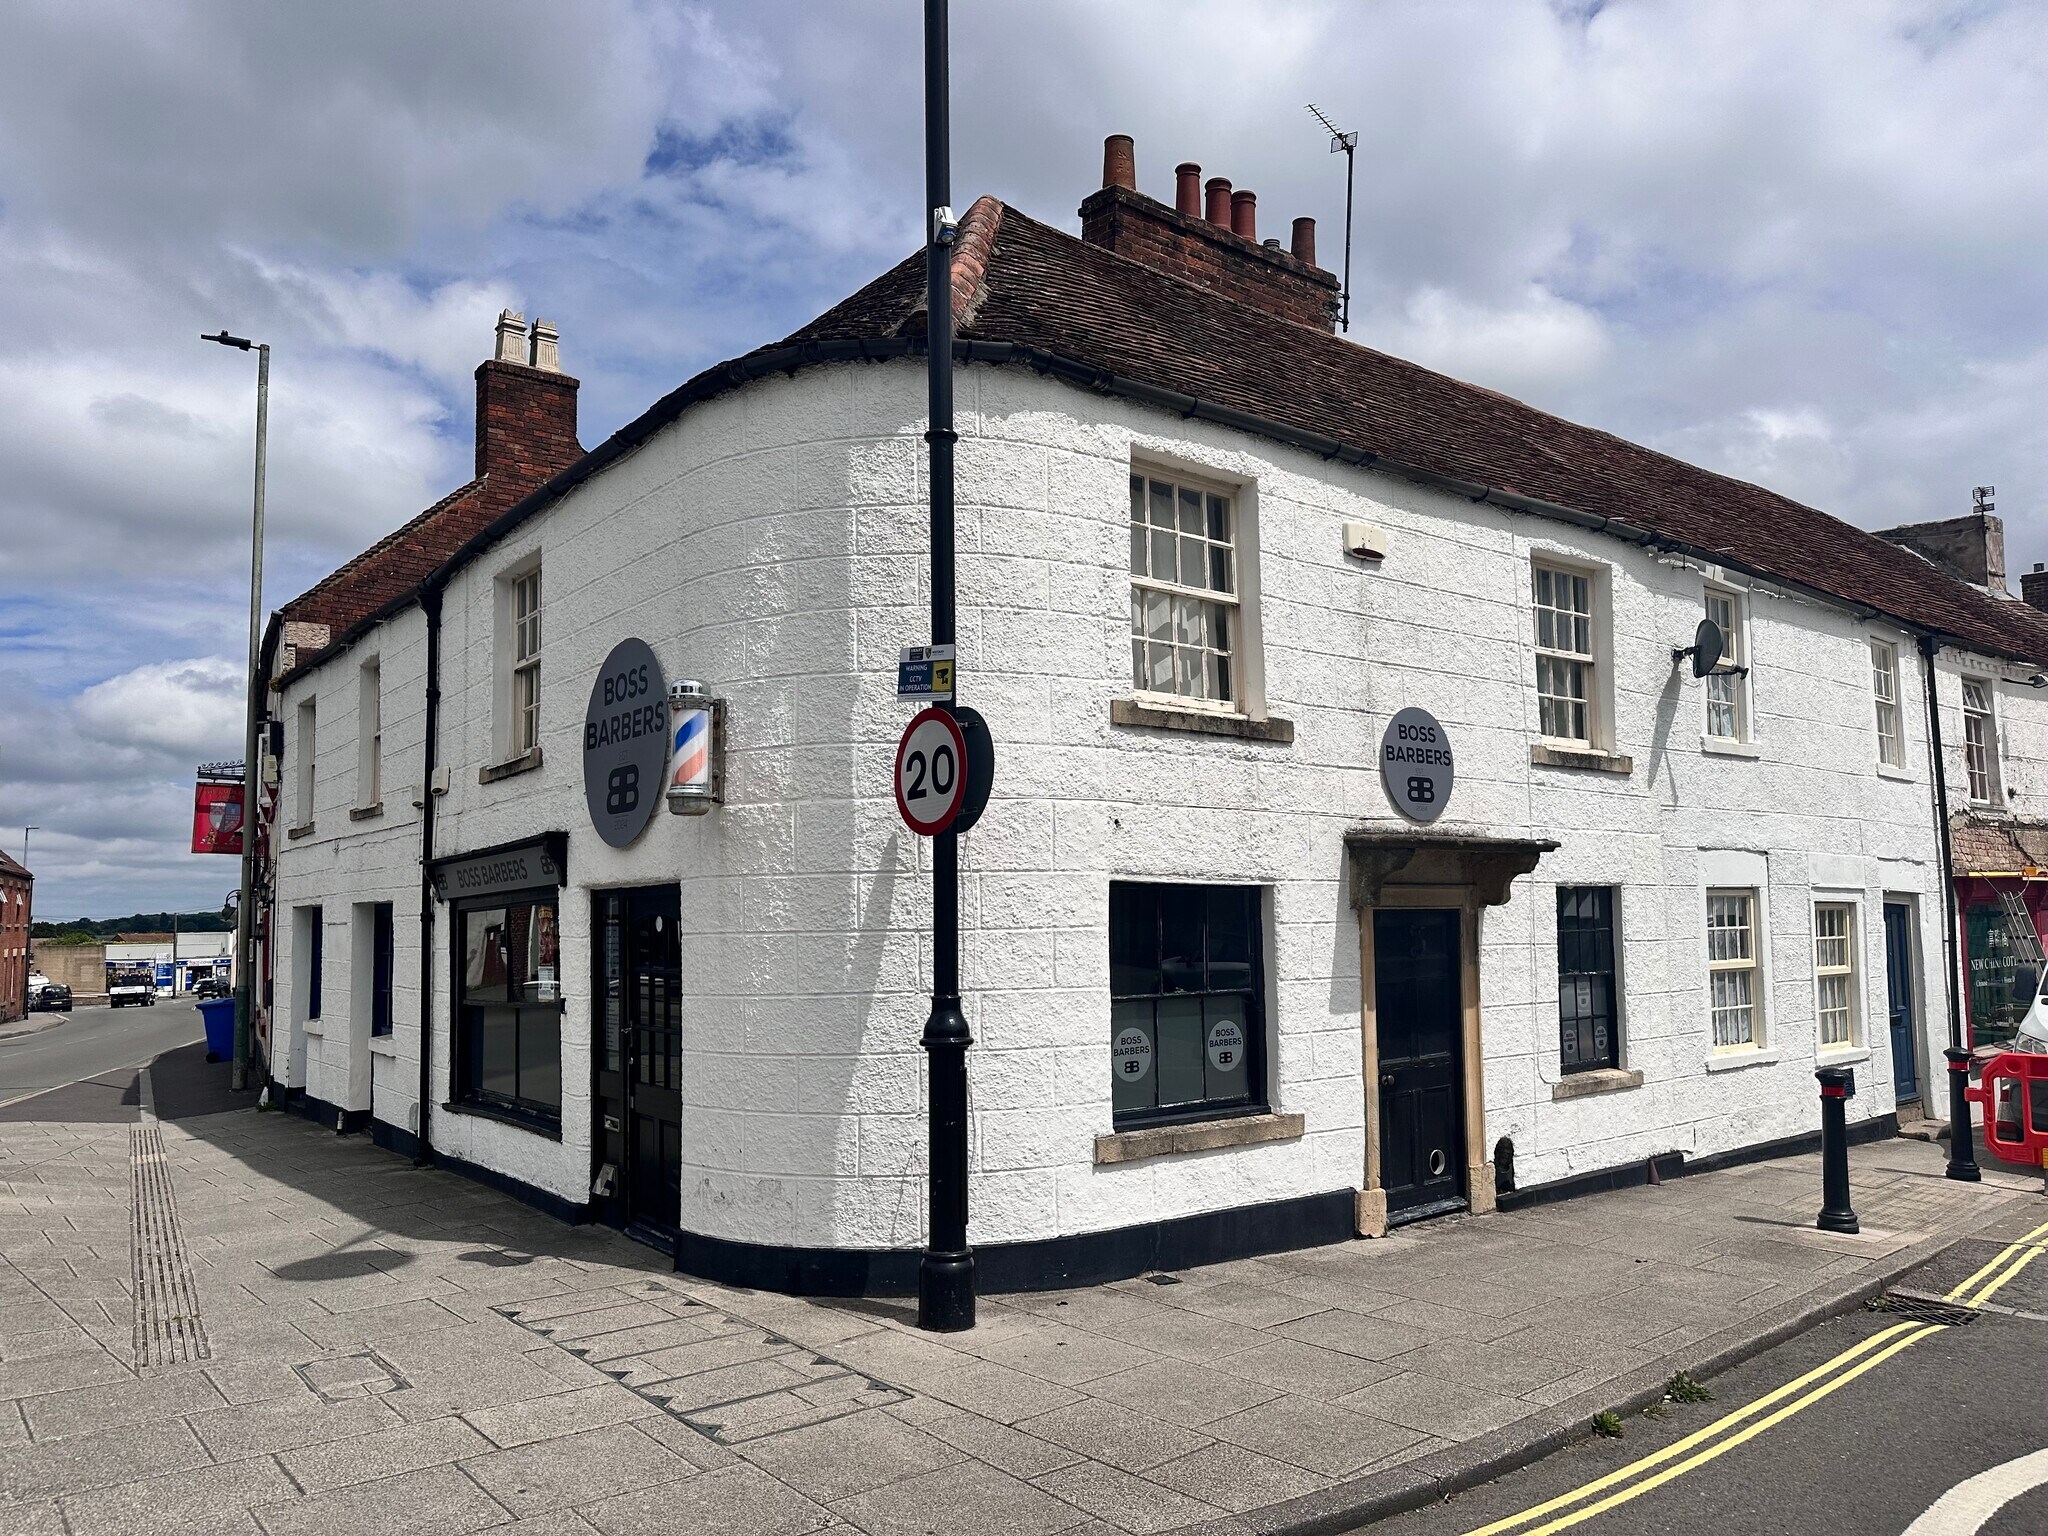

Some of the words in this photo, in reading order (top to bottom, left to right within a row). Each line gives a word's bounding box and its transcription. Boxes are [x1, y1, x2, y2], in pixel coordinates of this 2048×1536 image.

[905, 664, 928, 672] WARNING
[604, 664, 648, 706] BOSS
[909, 675, 923, 683] CCTV
[905, 684, 932, 692] OPERATION
[586, 700, 665, 751] BARBERS
[1398, 724, 1437, 743] BOSS
[1385, 745, 1452, 767] BARBERS
[906, 744, 955, 801] 20
[456, 866, 482, 889] BOSS
[481, 858, 528, 885] BARBERS
[1971, 958, 1984, 971] NEW
[1215, 1028, 1235, 1037] BOSS
[1120, 1036, 1142, 1046] BOSS
[1209, 1037, 1242, 1048] BARBERS
[1113, 1046, 1150, 1057] BARBERS
